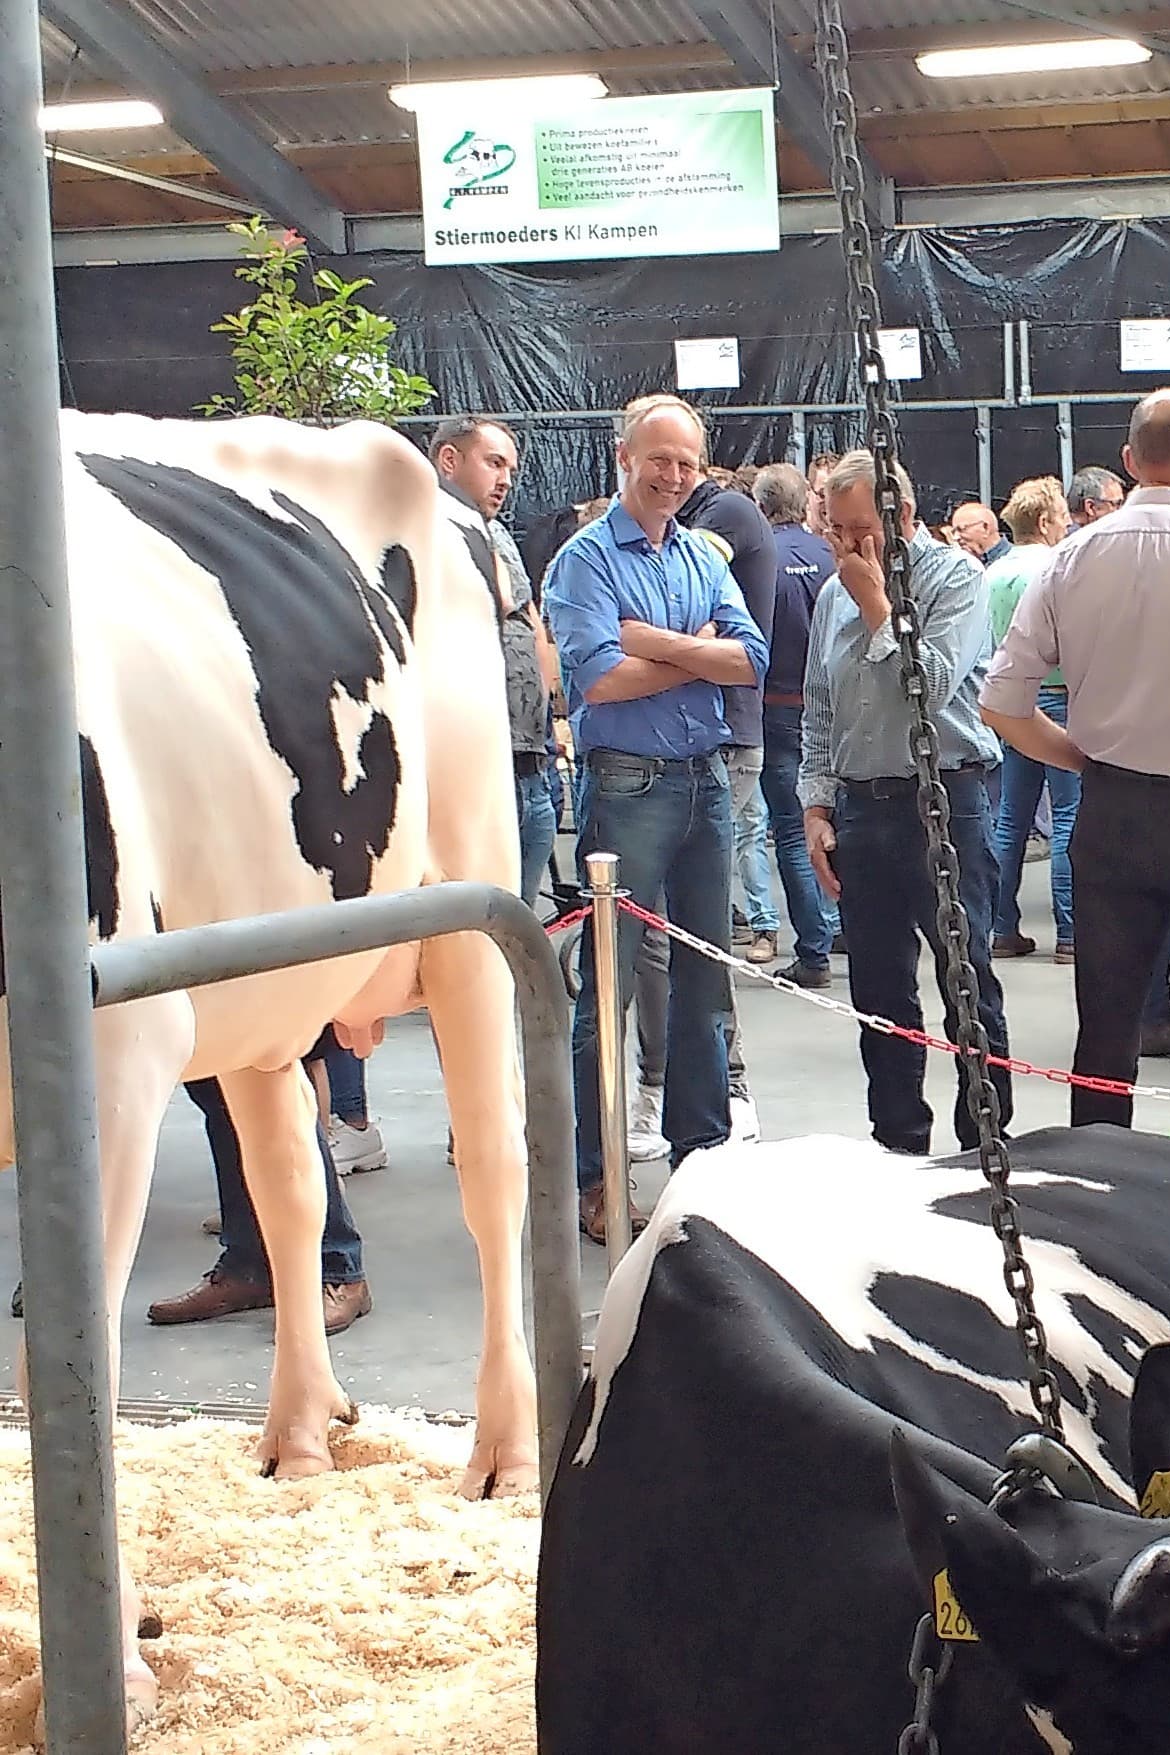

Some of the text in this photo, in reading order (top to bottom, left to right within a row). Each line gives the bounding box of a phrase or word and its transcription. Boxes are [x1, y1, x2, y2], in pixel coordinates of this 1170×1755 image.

[548, 129, 576, 139] Prima
[571, 165, 618, 178] generaties
[552, 191, 572, 202] Veel
[574, 190, 614, 201] aandacht
[435, 223, 658, 246] Stiermoeders KI Kampen
[940, 1601, 968, 1635] 26
